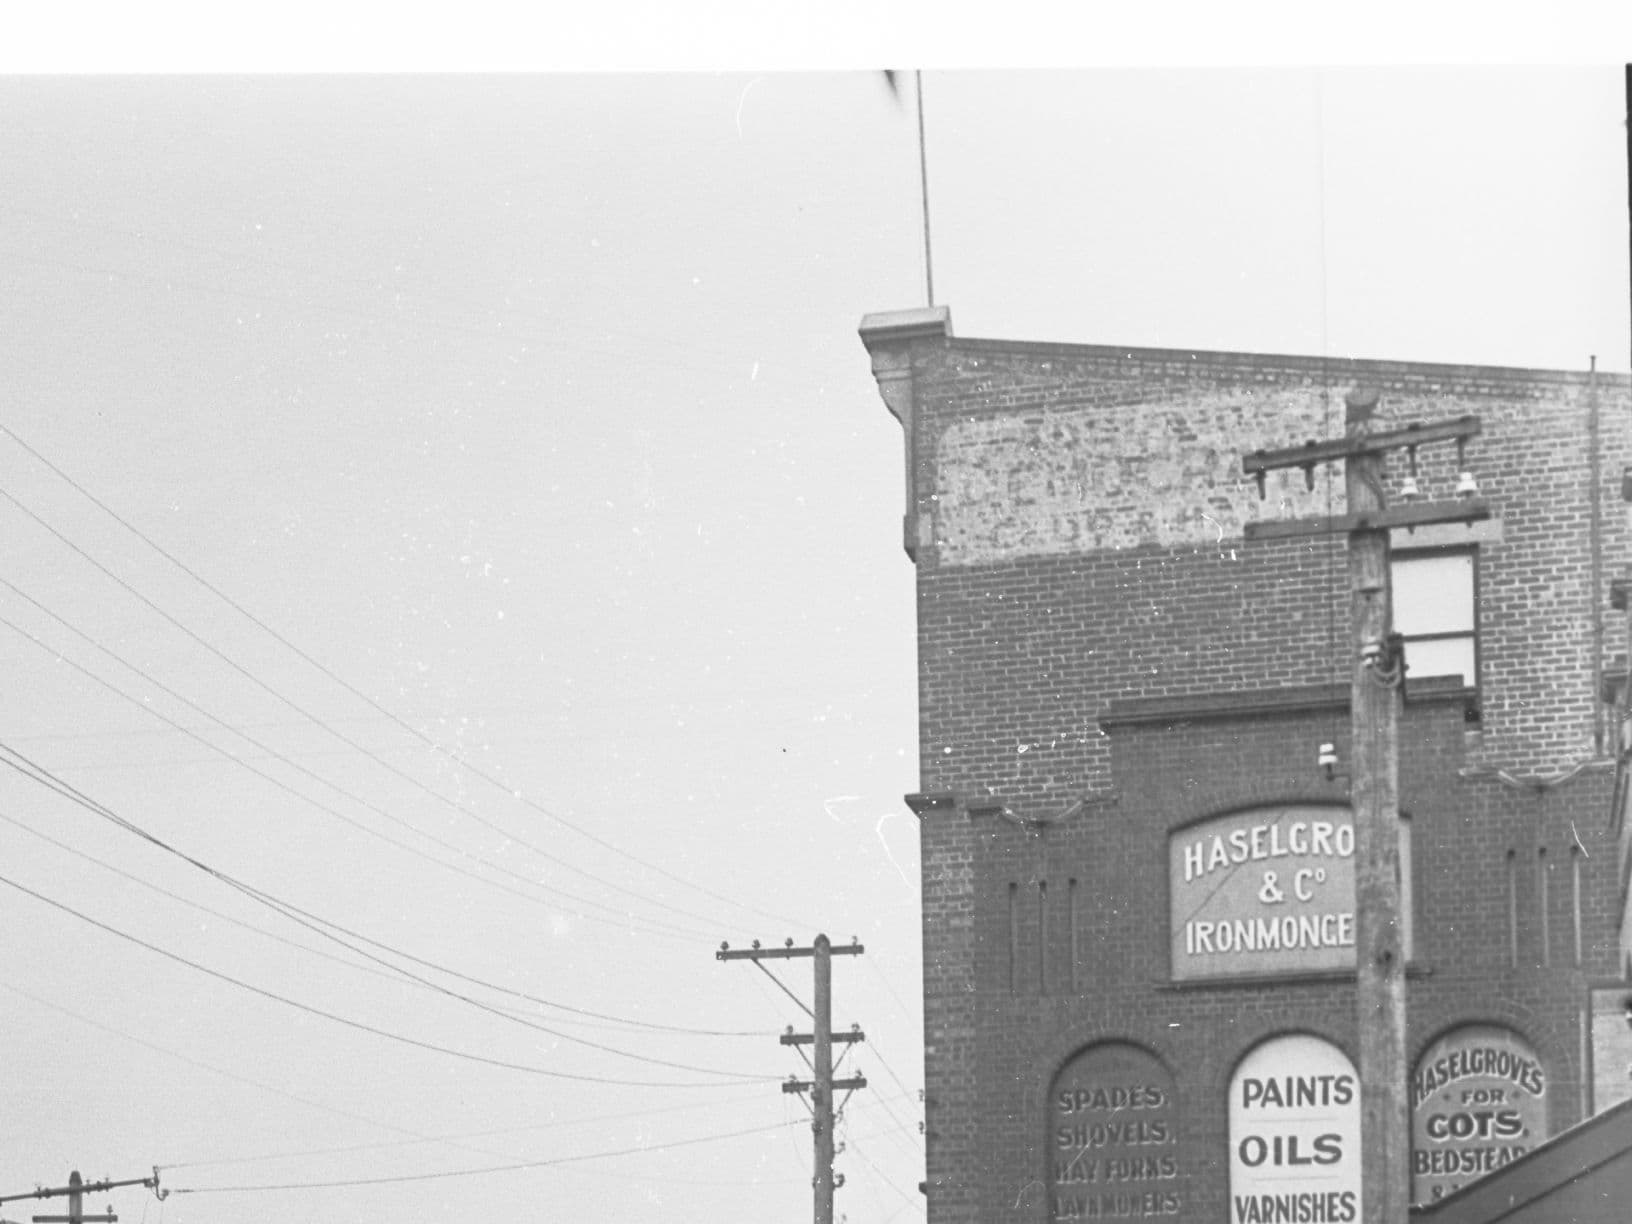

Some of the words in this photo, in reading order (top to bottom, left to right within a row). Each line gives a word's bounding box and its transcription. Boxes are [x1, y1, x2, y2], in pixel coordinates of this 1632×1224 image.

[1184, 822, 1355, 881] HASELGRO
[1259, 870, 1283, 903] &
[1186, 913, 1355, 954] IRONMONGE
[1243, 1075, 1354, 1109] PAINTS
[1461, 1088, 1504, 1104] FOR
[1239, 1133, 1343, 1167] OILS
[1235, 1191, 1356, 1224] VARNISHES
